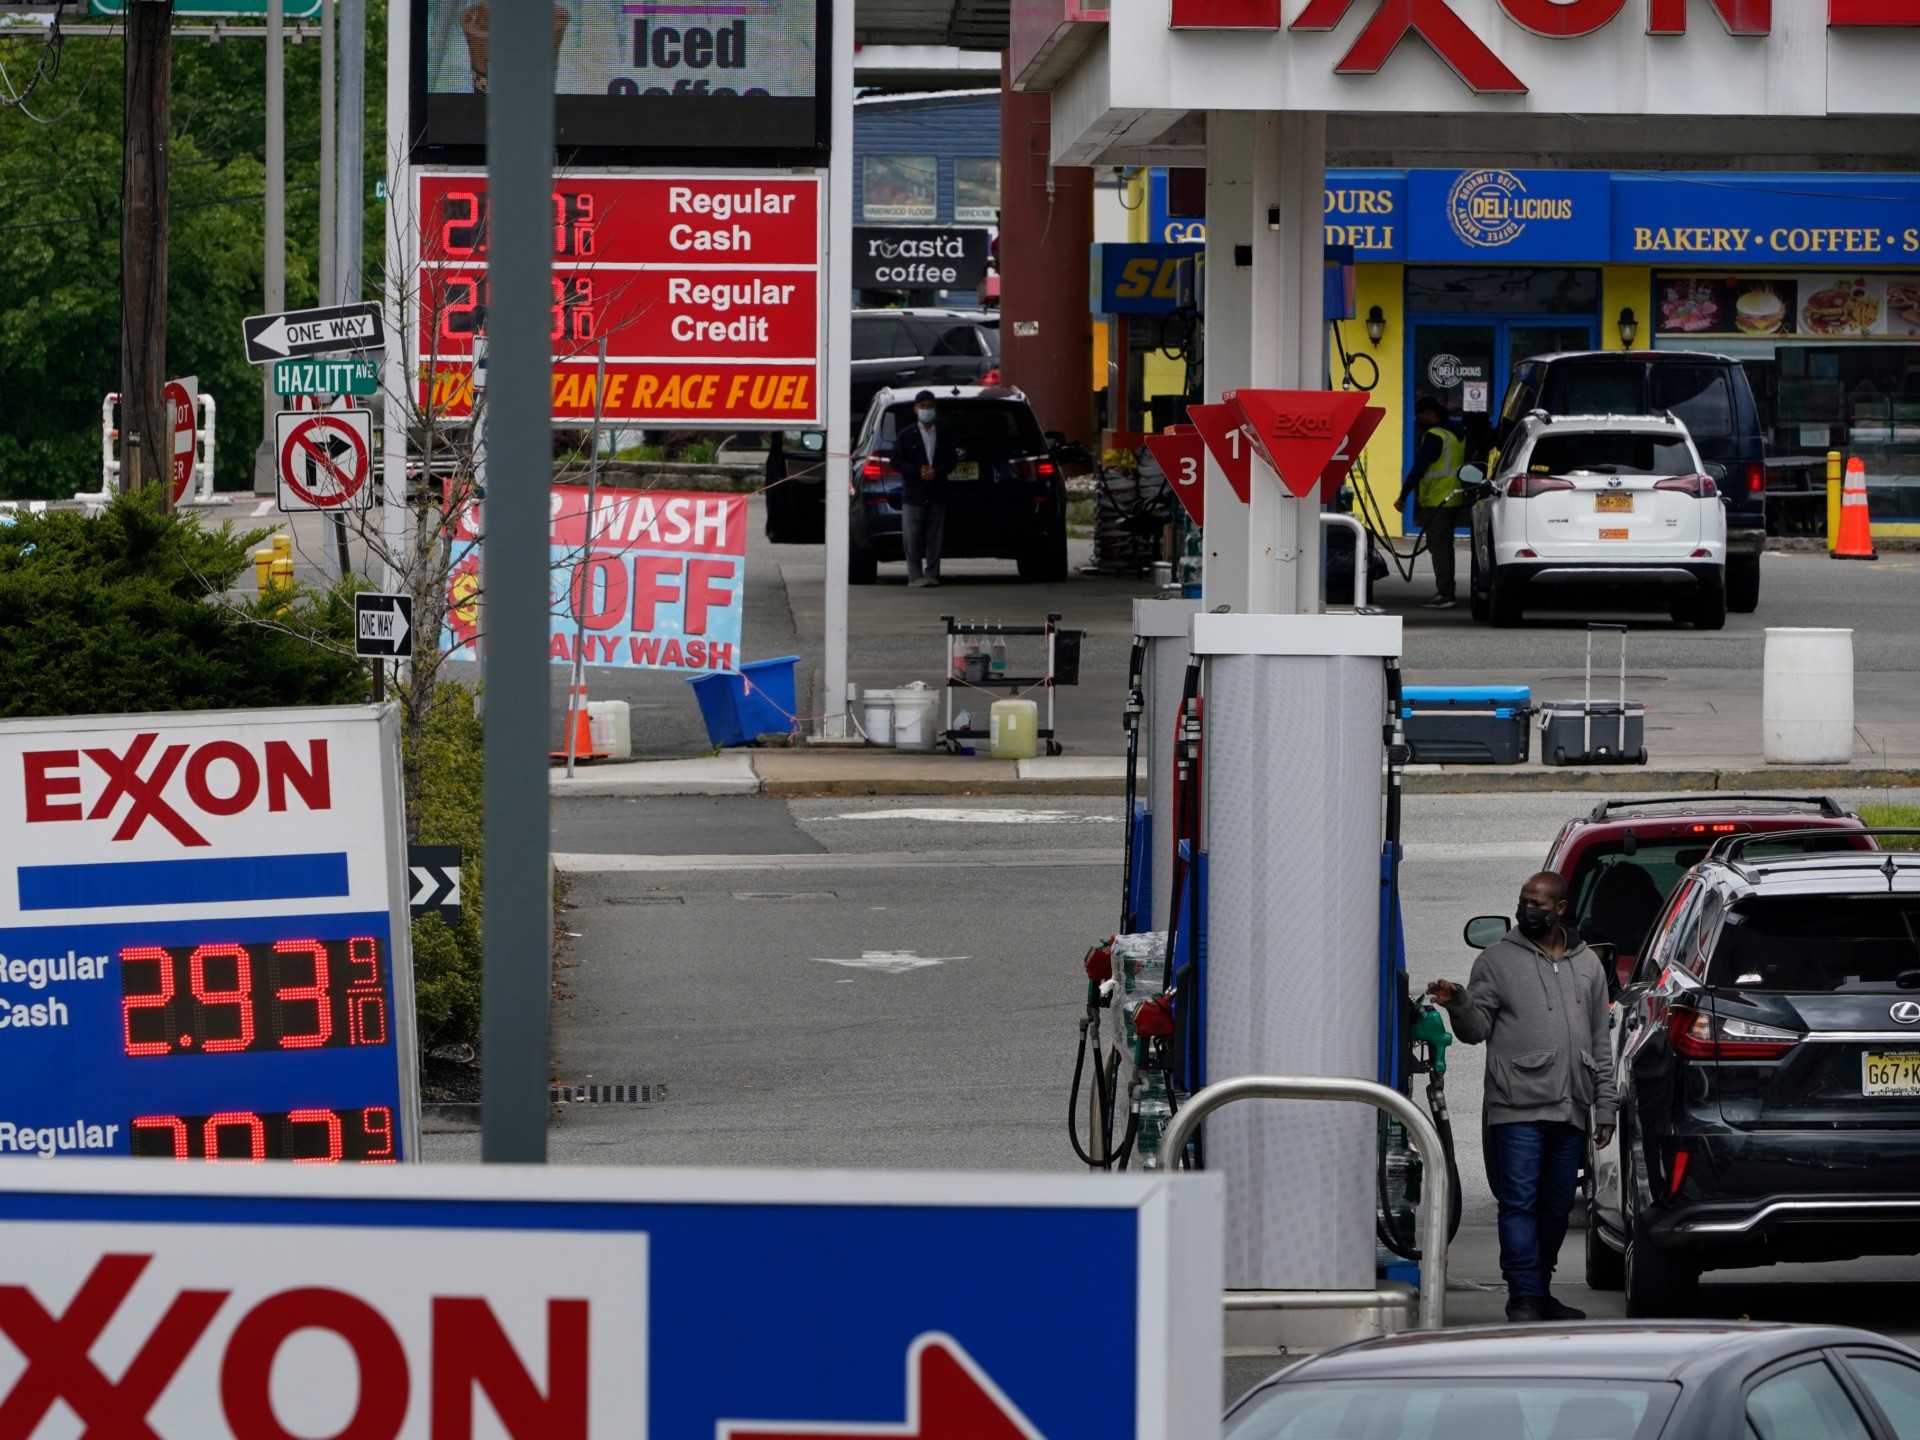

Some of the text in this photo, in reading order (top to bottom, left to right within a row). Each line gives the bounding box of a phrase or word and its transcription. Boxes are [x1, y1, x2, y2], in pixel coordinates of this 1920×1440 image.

[634, 18, 746, 69] Iced
[1460, 173, 1517, 201] GOURMET DELI
[669, 187, 796, 220] Regular
[669, 224, 751, 250] Cash
[1324, 226, 1393, 249] DELI
[1458, 207, 1518, 241] BAKERY COFFEE
[868, 236, 964, 258] roast'd
[1634, 227, 1750, 250] BAKERY
[1770, 228, 1881, 251] COFFEE
[876, 264, 957, 282] coffee
[668, 278, 795, 311] Regular
[286, 317, 367, 343] ONE WAY
[671, 315, 769, 342] Credit
[278, 364, 374, 393] HAZLITT AVE
[631, 374, 720, 409] RACE
[725, 375, 809, 410] FUEL
[175, 404, 189, 425] OT
[1275, 413, 1332, 435] Exxon
[1225, 429, 1239, 459] 1
[1178, 457, 1197, 485] 3
[583, 494, 727, 547] WASH
[570, 551, 736, 636] OFF
[361, 613, 394, 637] ONE WAY
[551, 633, 733, 671] ANY WASH
[22, 732, 331, 847] EXXON
[119, 939, 332, 1056] 2.93
[1869, 1063, 1900, 1085] G67
[0, 1119, 119, 1160] Regular
